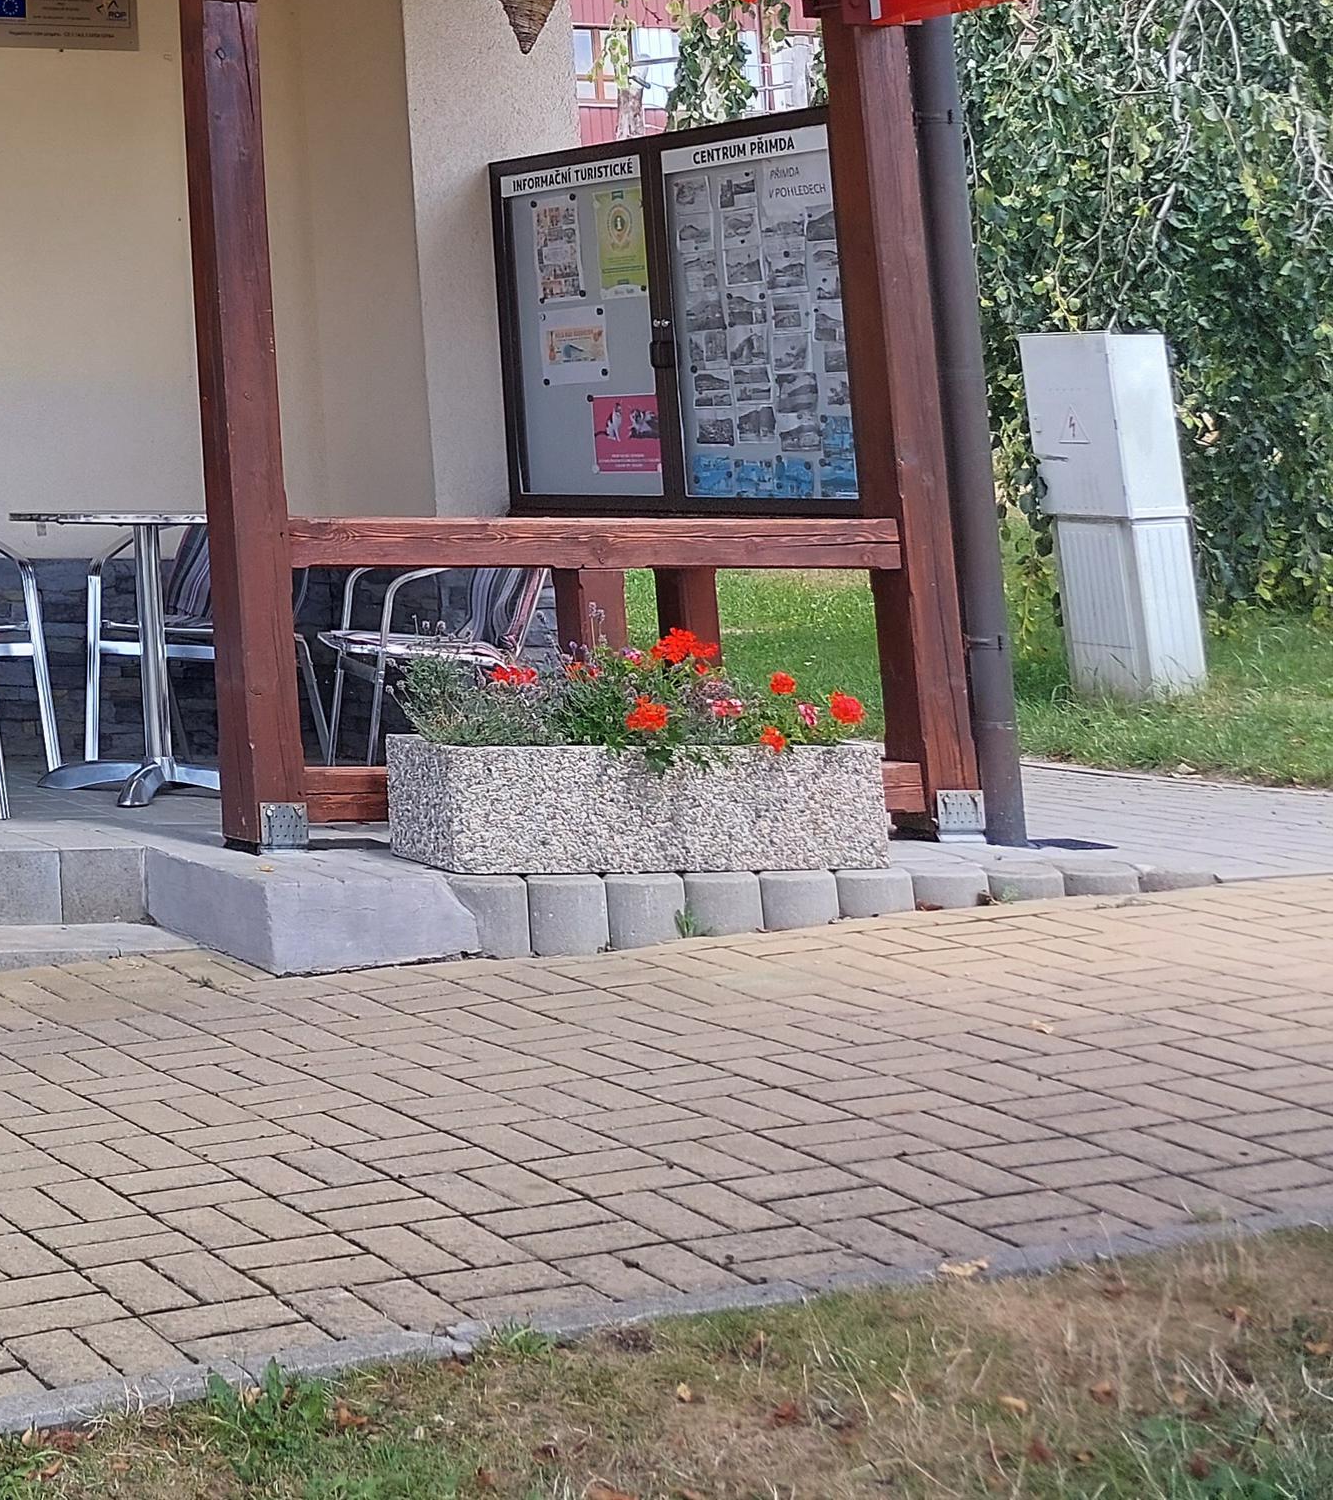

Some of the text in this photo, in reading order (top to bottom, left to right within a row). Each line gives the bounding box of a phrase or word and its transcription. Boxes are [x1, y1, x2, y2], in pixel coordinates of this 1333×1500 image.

[693, 136, 795, 165] CENTRUM PŘIMDA
[513, 158, 633, 192] INFORMAČNÍ TURISTICKÉ
[775, 184, 826, 198] POHLEDECH
